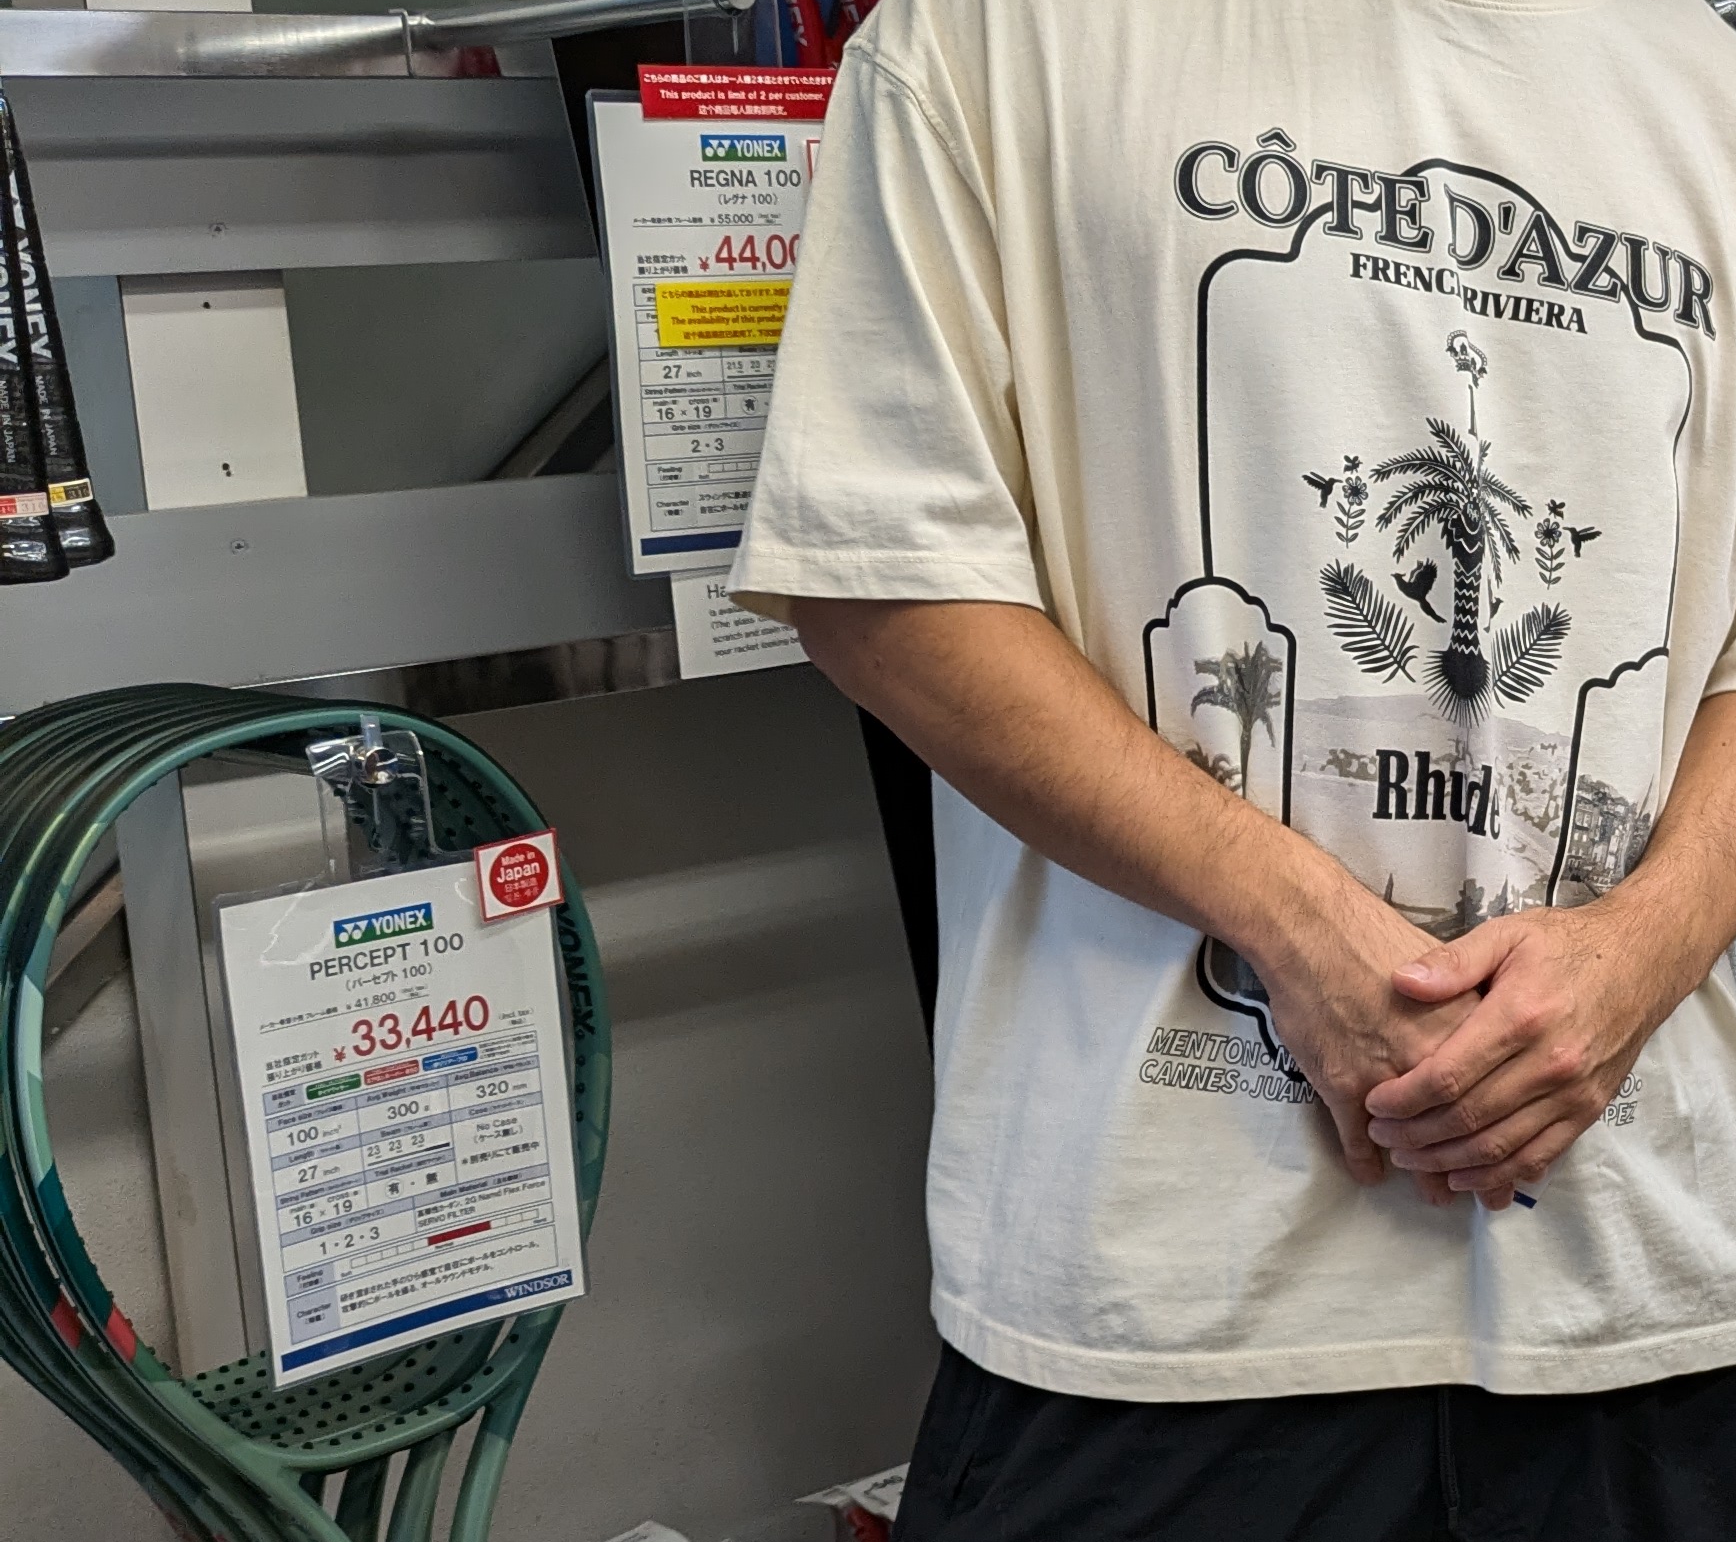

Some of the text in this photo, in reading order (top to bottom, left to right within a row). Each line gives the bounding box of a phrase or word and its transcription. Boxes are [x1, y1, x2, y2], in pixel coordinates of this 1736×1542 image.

[660, 89, 679, 100] This
[681, 89, 716, 101] product
[728, 89, 746, 100] limit
[748, 89, 757, 100] of
[760, 90, 767, 100] 2
[768, 91, 783, 102] per
[734, 139, 781, 158] YONEX
[690, 168, 802, 188] REGNA 100
[751, 193, 779, 207] 100)
[1174, 128, 1717, 340] CÔTE D'AZUR
[1350, 252, 1588, 335] FRENC RIVIERA
[671, 315, 756, 327] The availability this
[691, 304, 733, 315] This product
[662, 365, 683, 379] 27
[656, 405, 713, 422] 16 19
[1372, 747, 1502, 841] Rhude
[501, 850, 536, 866] Made in
[497, 861, 541, 884] Japan
[372, 908, 430, 937] YONEX
[310, 932, 464, 981] PERCEPT 100
[402, 963, 433, 980] 100)
[558, 906, 598, 1038] YONEX
[334, 994, 490, 1064] ¥33,440
[286, 1079, 510, 1146] 100 300 320
[476, 1115, 519, 1132] No Case
[297, 1132, 426, 1184] 27 23 23 23
[293, 1199, 353, 1228] 16 19
[504, 1272, 571, 1300] WINDSOR
